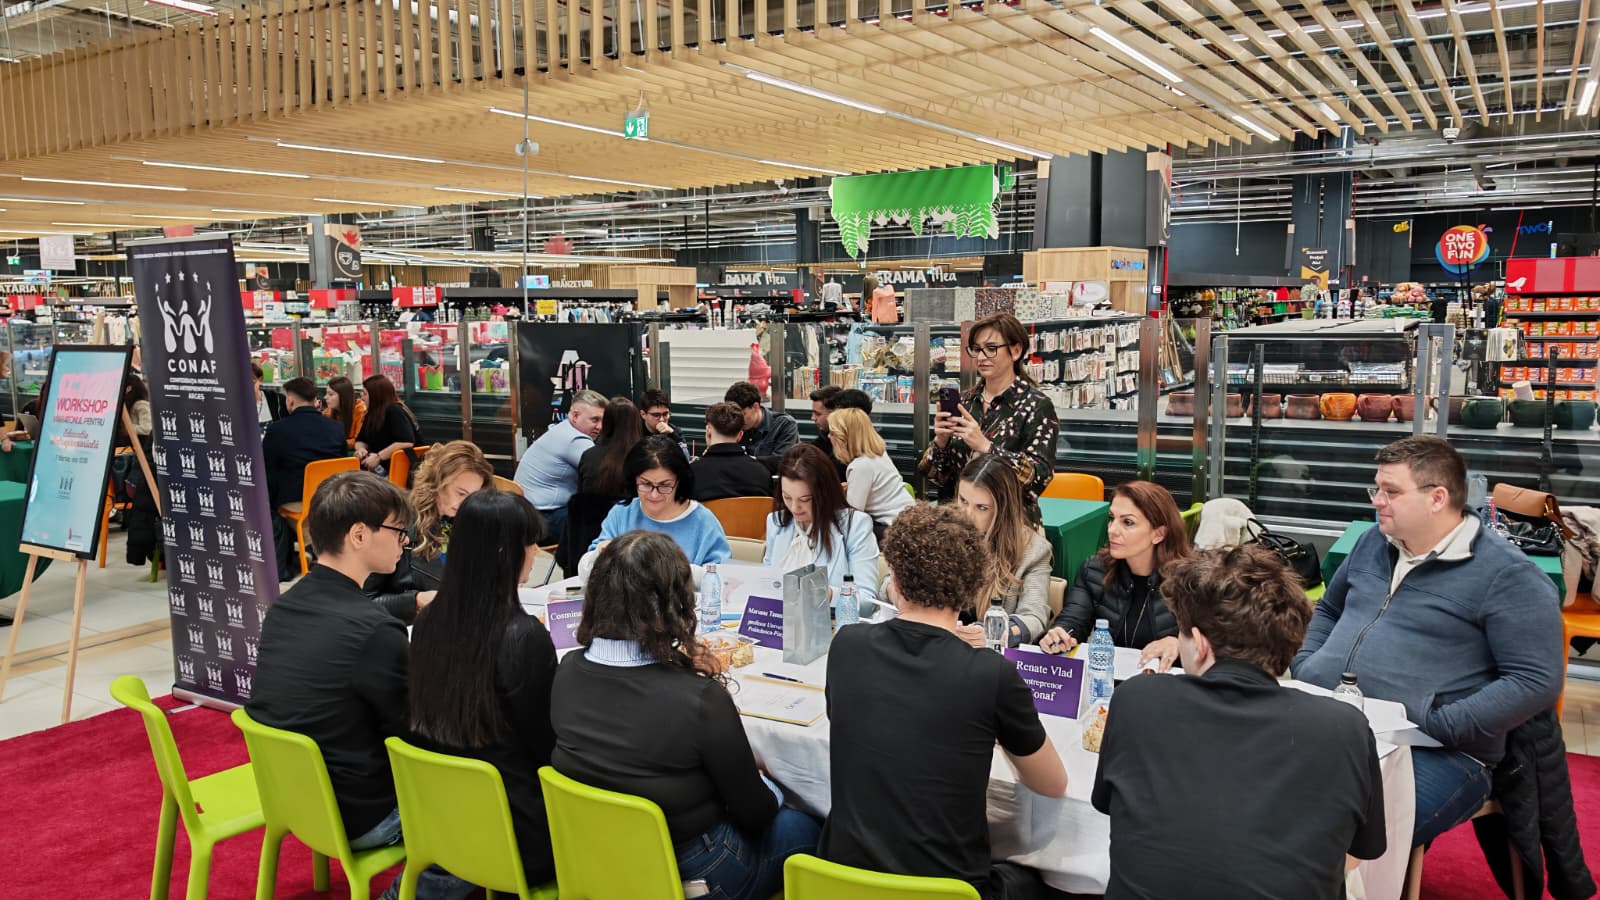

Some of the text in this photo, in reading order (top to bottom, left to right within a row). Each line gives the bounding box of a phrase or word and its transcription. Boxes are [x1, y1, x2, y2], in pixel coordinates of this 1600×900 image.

[1445, 232, 1475, 242] ONE
[1445, 241, 1475, 250] TWO
[1447, 249, 1474, 259] FUN
[167, 359, 217, 373] CONAF
[57, 398, 108, 414] WORKSHOP
[1016, 660, 1073, 678] Renate Vlad
[1031, 688, 1057, 701] onaf
